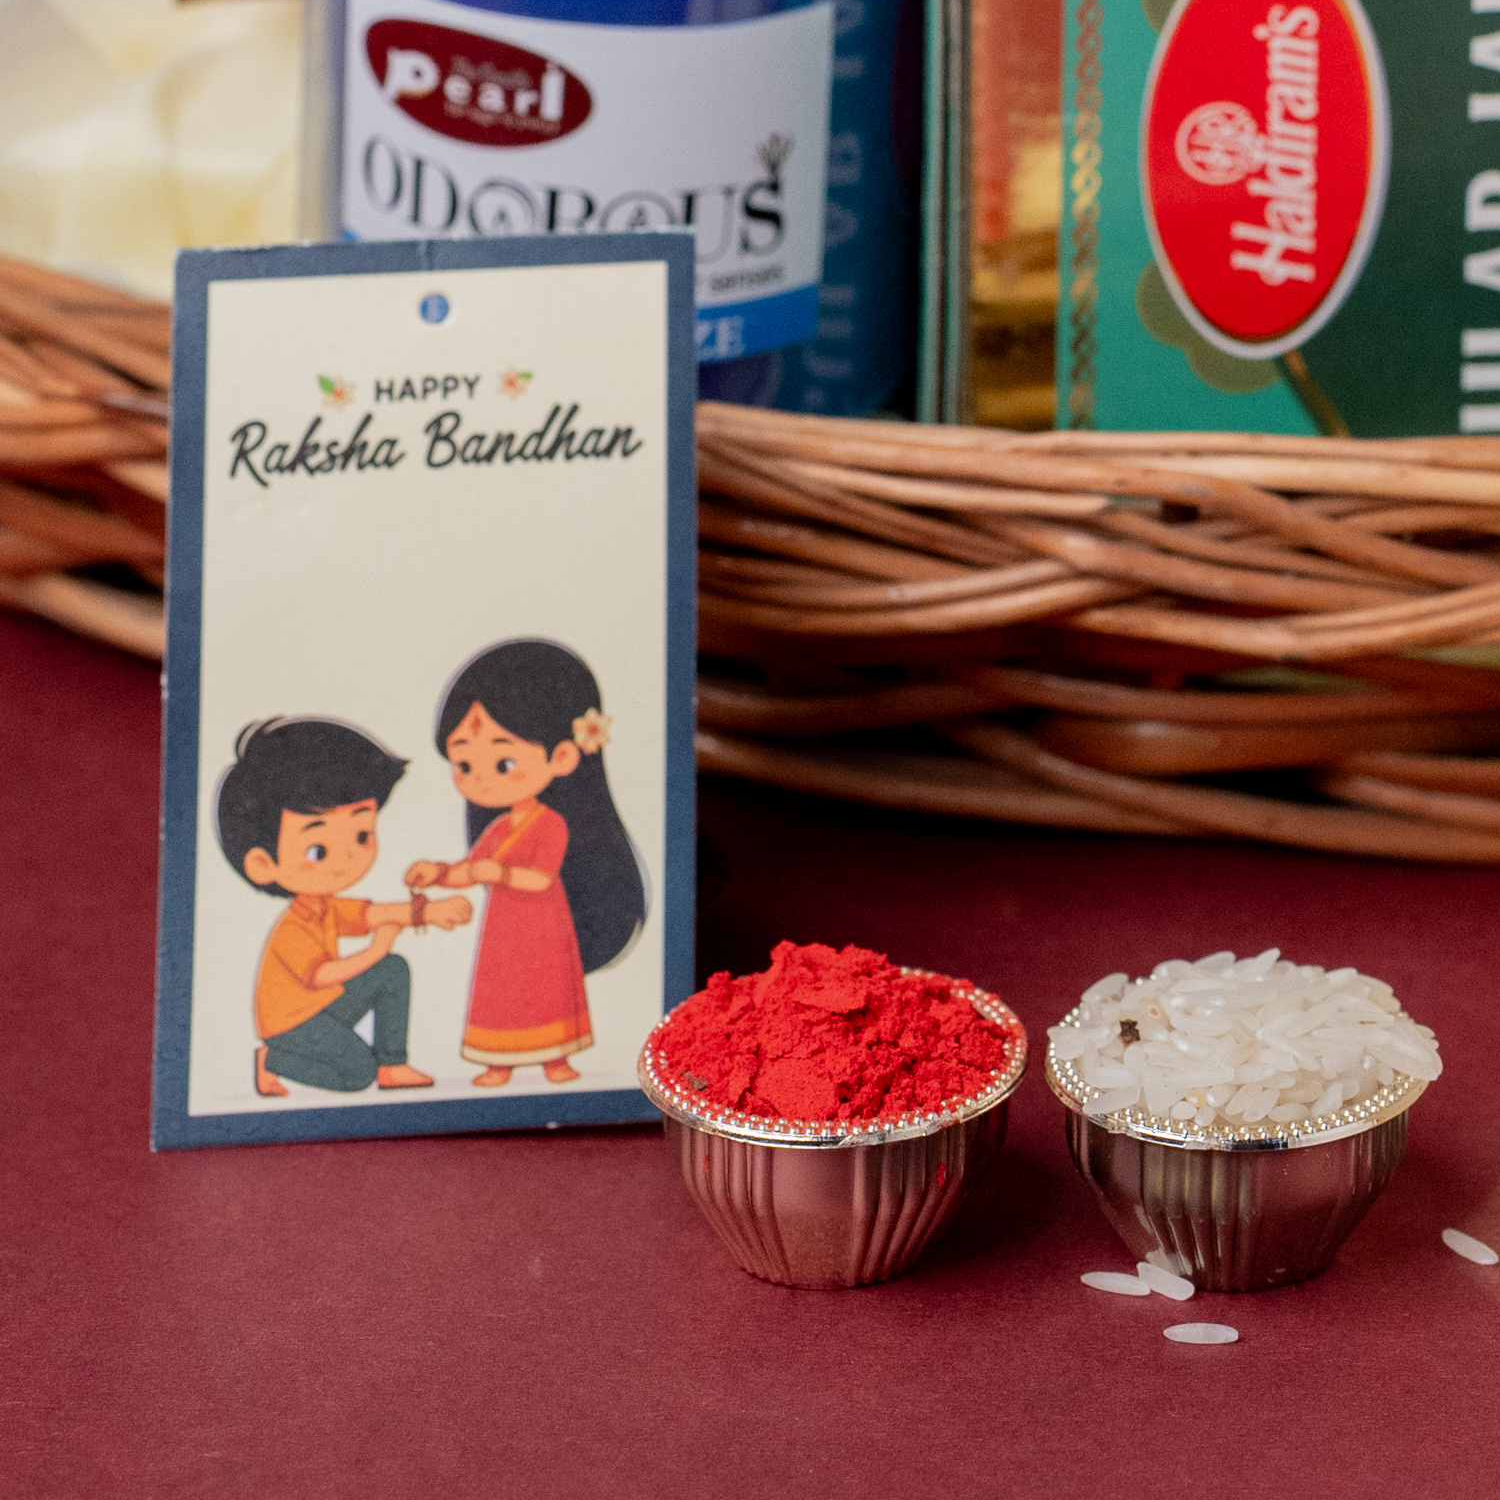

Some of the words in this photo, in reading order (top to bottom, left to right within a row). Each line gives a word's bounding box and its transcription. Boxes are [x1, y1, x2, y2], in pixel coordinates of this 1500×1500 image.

[1228, 3, 1321, 287] Haldiram's
[374, 374, 482, 403] HAPPY
[229, 412, 406, 488] Raksha
[424, 402, 643, 470] Bandhan
